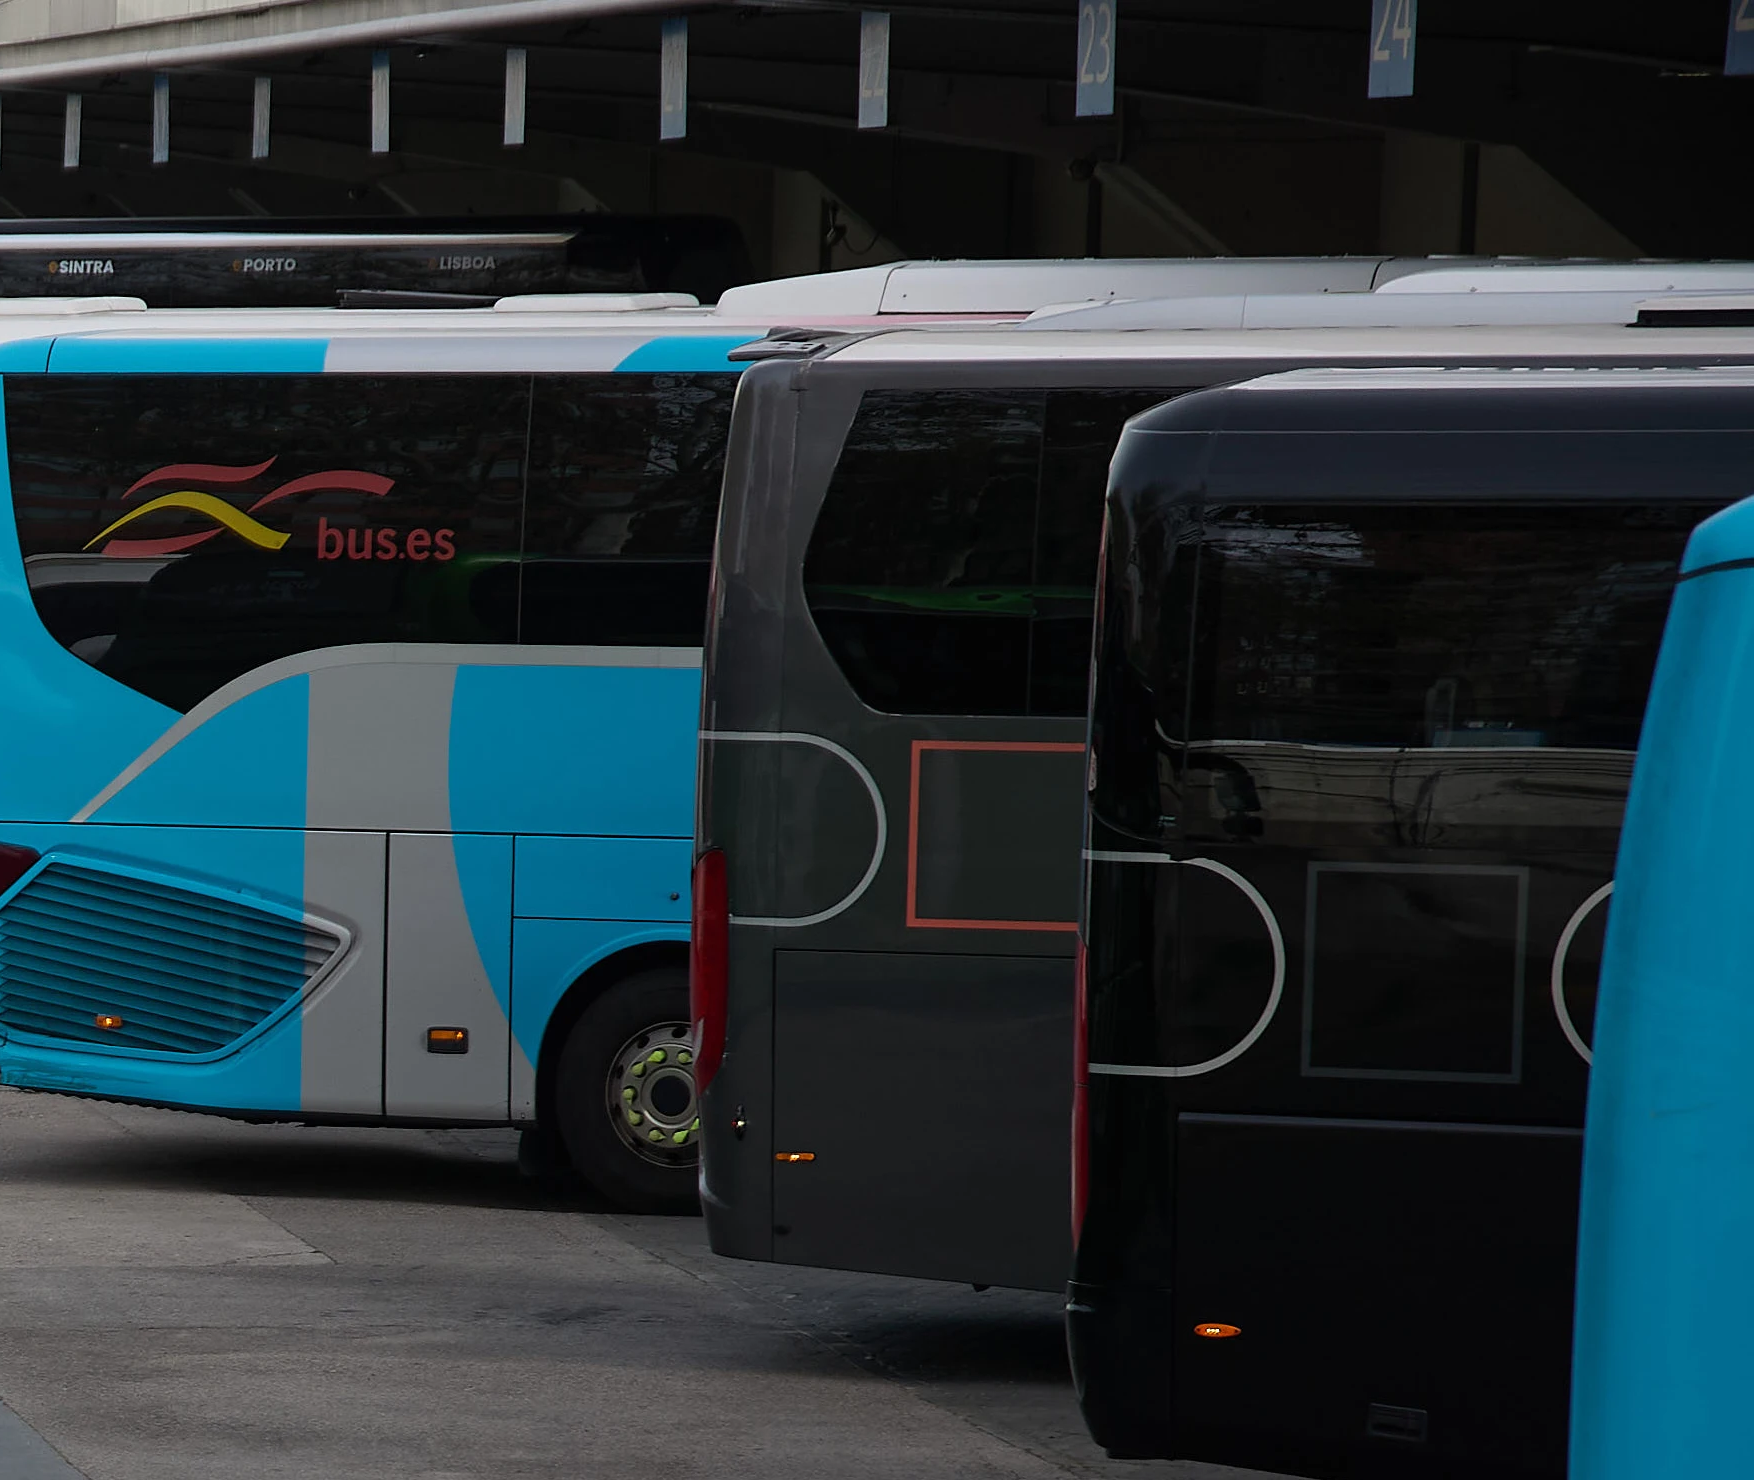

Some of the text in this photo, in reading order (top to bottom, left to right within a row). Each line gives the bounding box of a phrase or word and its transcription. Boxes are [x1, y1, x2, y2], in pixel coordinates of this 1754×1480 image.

[1081, 4, 1112, 84] 23
[1373, 0, 1411, 61] 24
[58, 259, 115, 274] SINTRA
[243, 257, 297, 272] PORTO
[440, 256, 497, 271] LISBOA
[317, 516, 455, 561] bus.es
